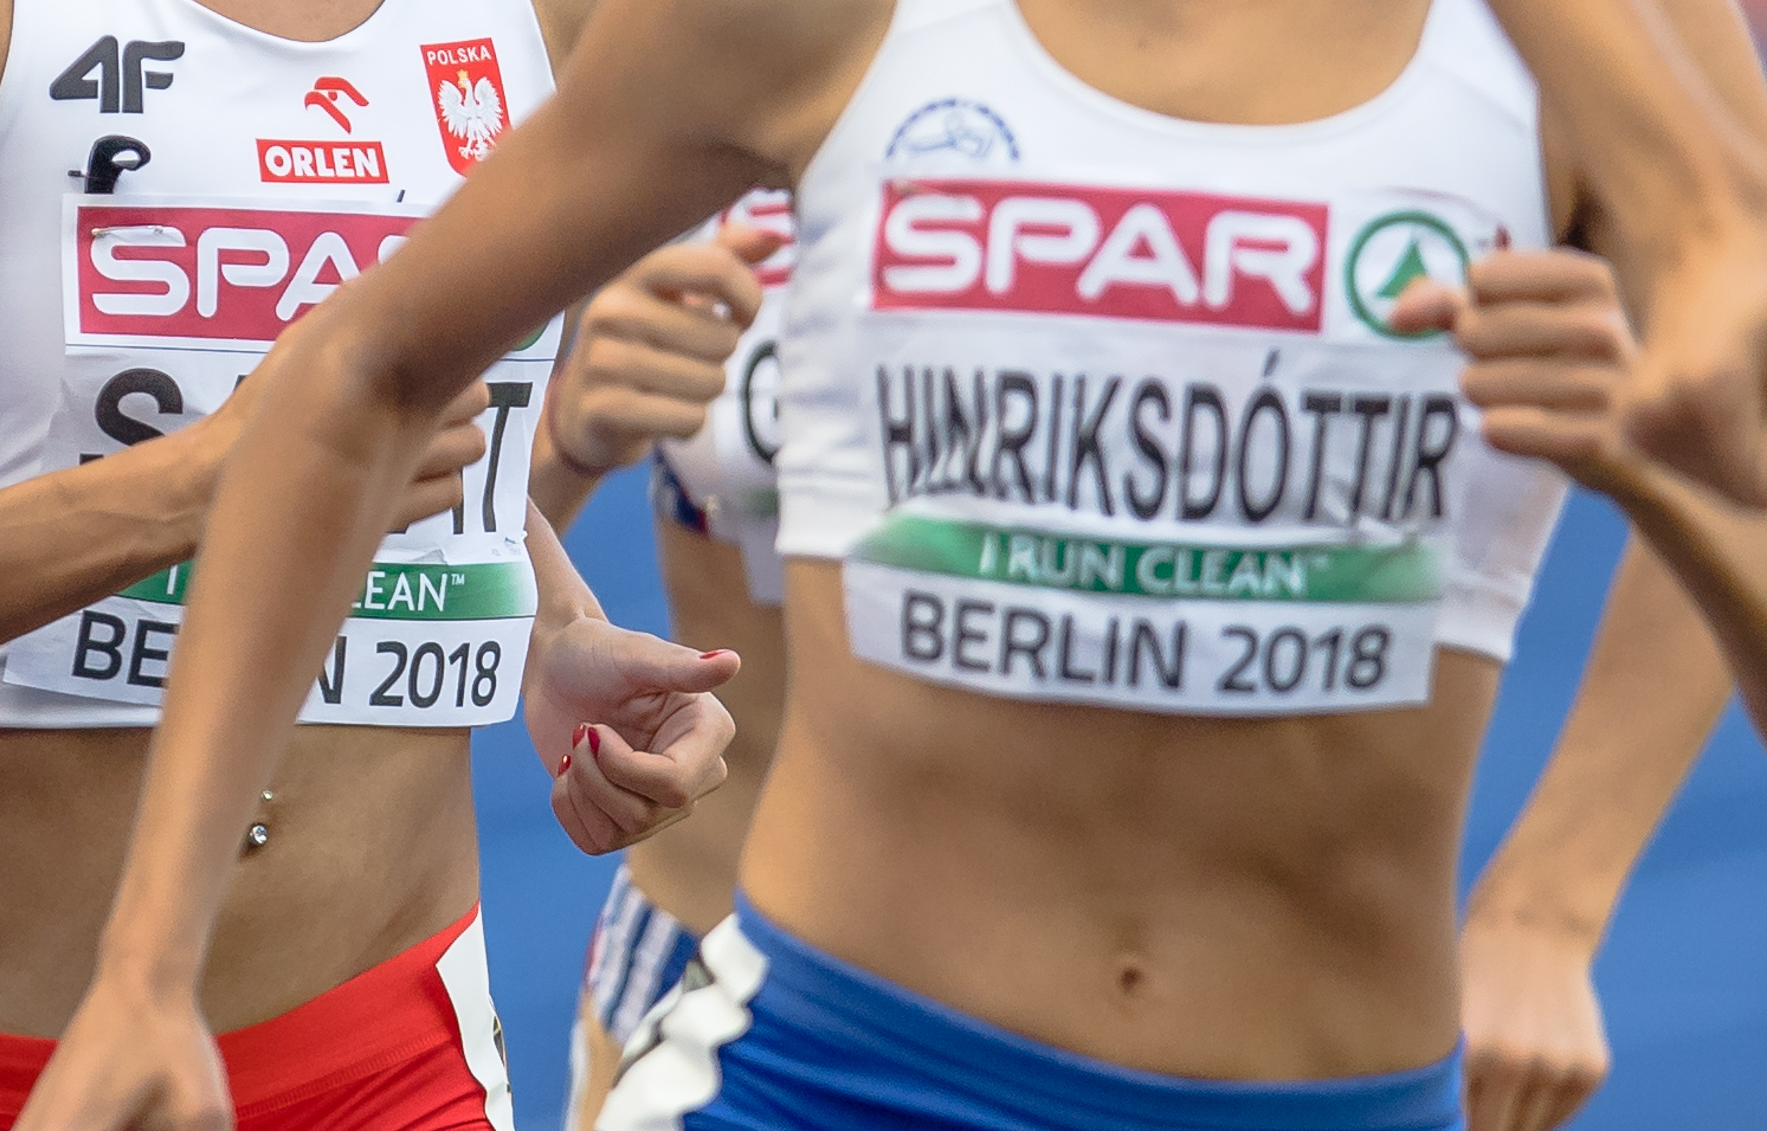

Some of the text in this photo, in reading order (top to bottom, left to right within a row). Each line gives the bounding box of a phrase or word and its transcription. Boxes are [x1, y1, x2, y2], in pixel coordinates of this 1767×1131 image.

[49, 35, 185, 113] 4F
[426, 45, 492, 66] POLSKA
[264, 144, 380, 178] ORLEN
[90, 225, 409, 321] SPA
[882, 194, 1319, 315] SPAR
[876, 349, 1457, 526] HINRIKSDÓTTIR
[979, 533, 999, 576] I
[1007, 535, 1125, 590] RUN
[71, 609, 502, 709] BEN 2018
[901, 589, 1393, 694] BERLIN 2018
